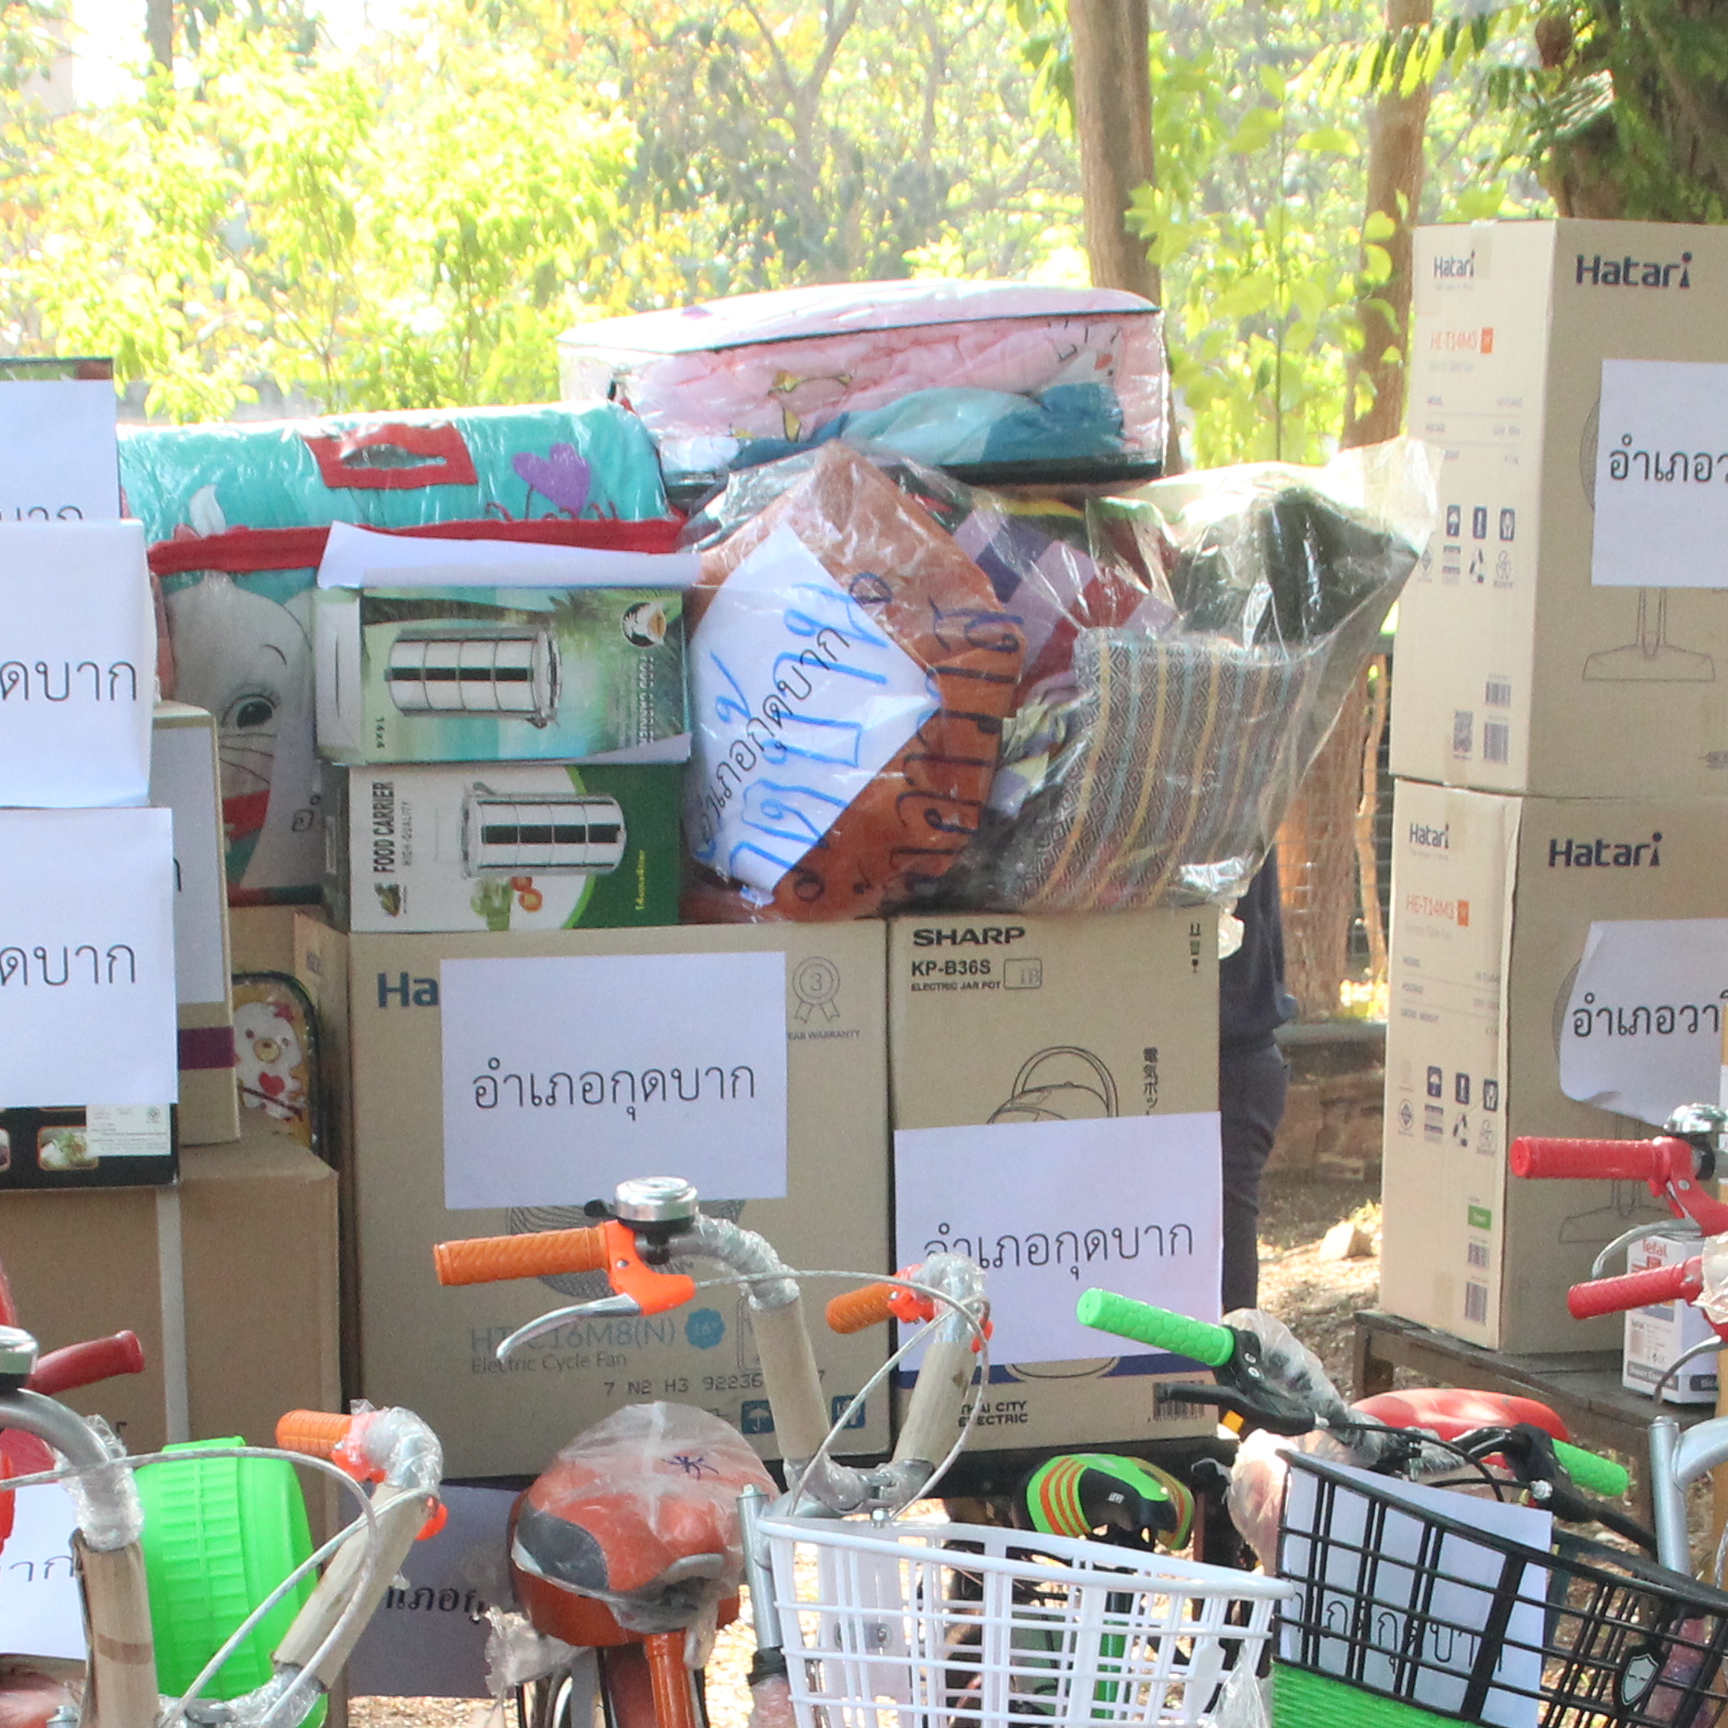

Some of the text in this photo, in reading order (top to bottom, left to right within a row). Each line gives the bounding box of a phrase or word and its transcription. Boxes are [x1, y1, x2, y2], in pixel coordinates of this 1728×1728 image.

[1576, 252, 1692, 288] Hatari
[373, 782, 396, 873] FOOD CARRIER
[1548, 831, 1664, 868] Hatari
[913, 927, 1026, 946] SHARP
[911, 959, 991, 976] KP-B36S
[911, 980, 1001, 991] ELECTRIC JAR POT
[472, 1057, 757, 1121] อำเภอกุดบาก
[1143, 1046, 1159, 1115] 電気ポッ
[542, 1352, 590, 1371] Cycle
[596, 1352, 628, 1367] Fan
[996, 1400, 1028, 1412] CITY
[959, 1412, 1029, 1428] EECTRIC
